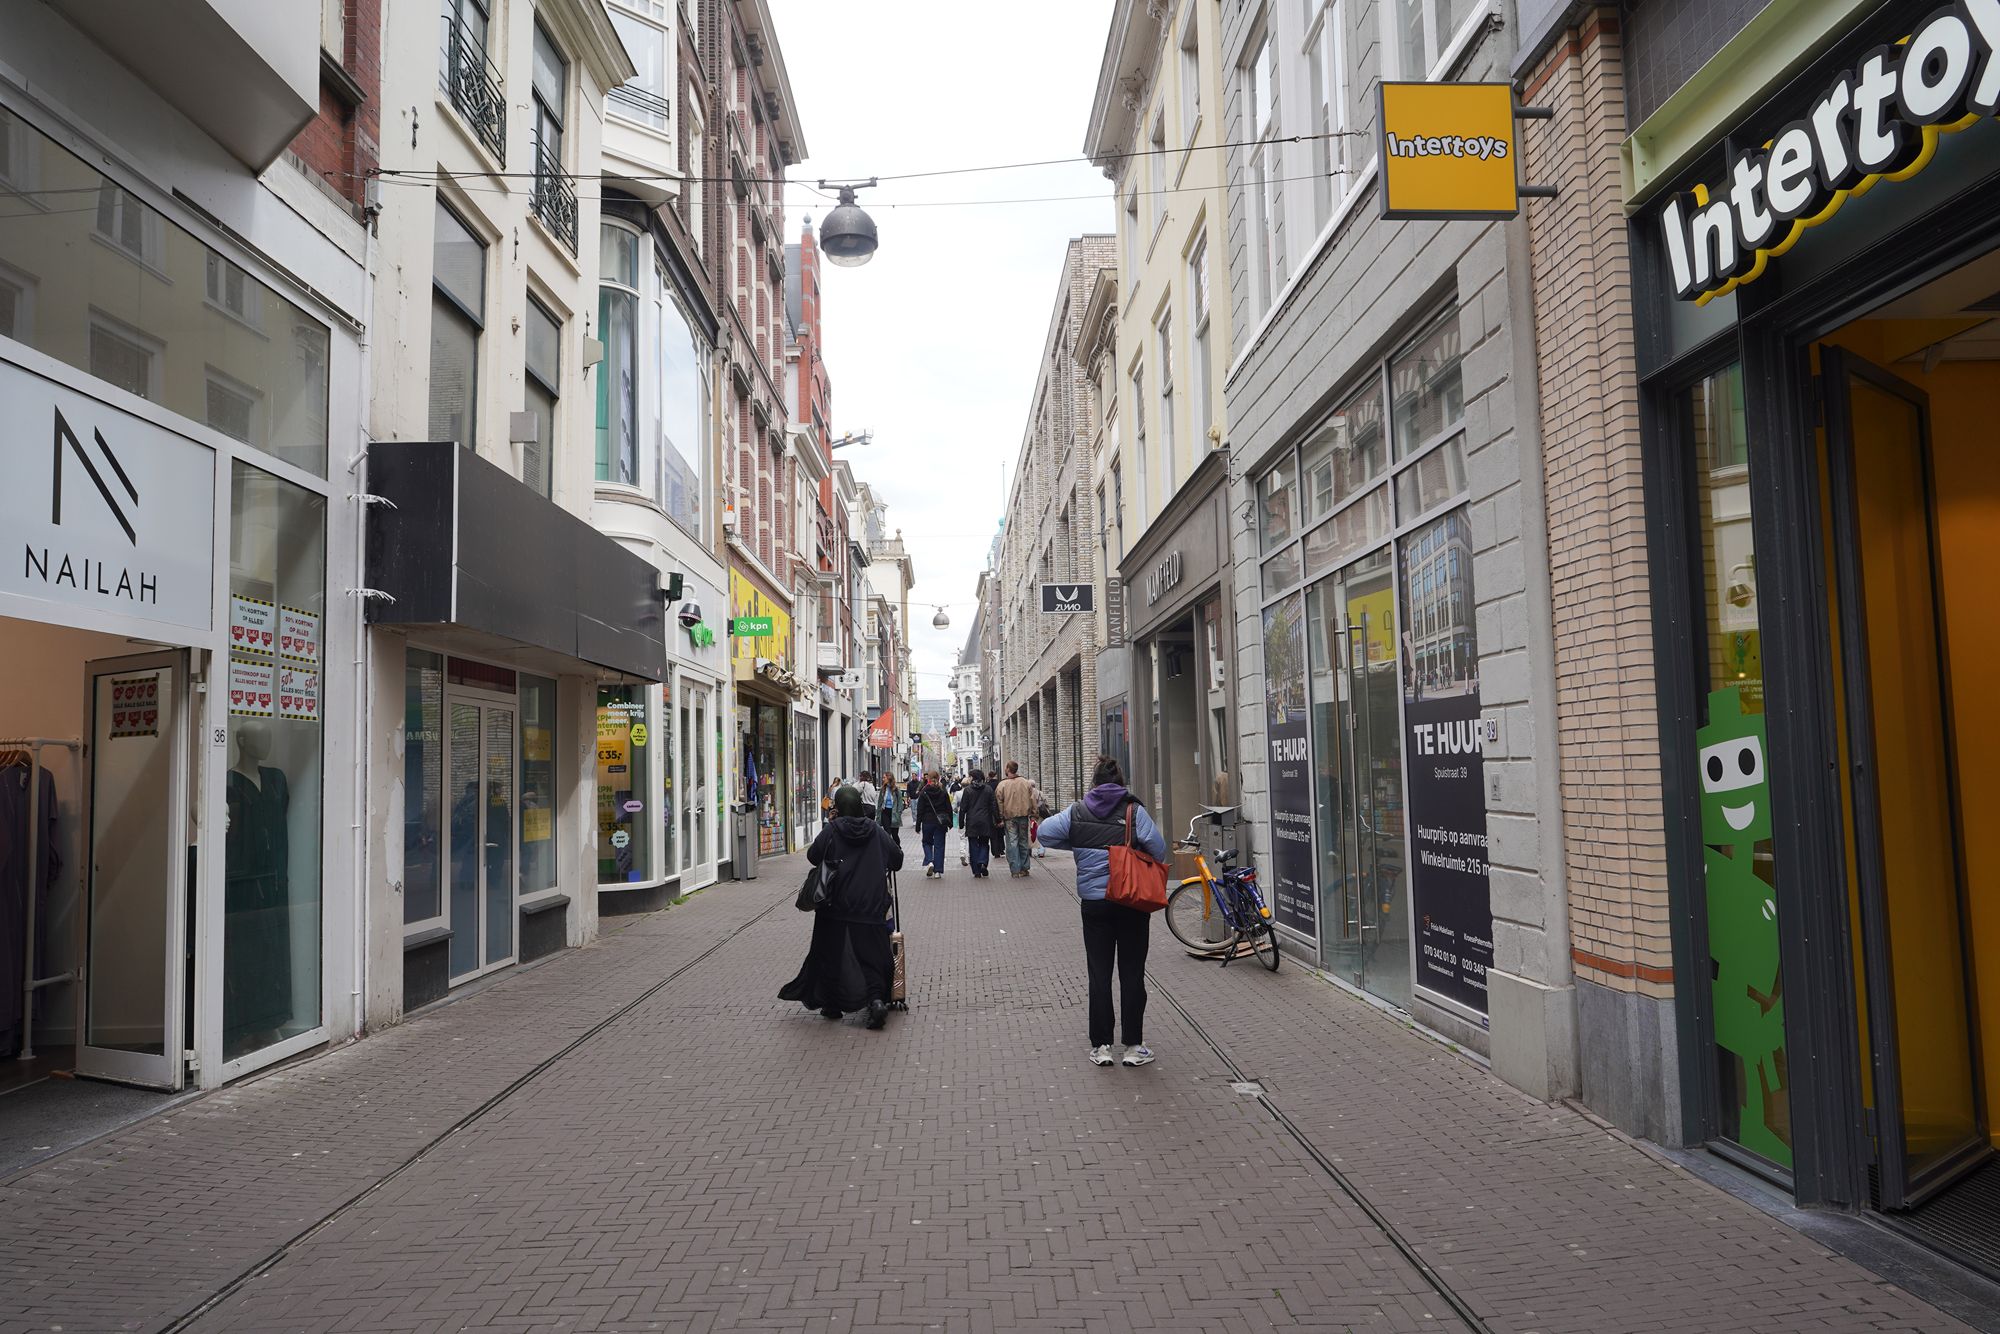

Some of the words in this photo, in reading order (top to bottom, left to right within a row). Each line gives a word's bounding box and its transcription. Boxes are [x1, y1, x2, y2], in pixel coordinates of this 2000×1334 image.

[1387, 132, 1508, 160] Intertoys
[25, 543, 156, 604] NAILAH
[247, 608, 268, 617] KORTING
[1054, 603, 1081, 611] ZUMO
[1110, 578, 1121, 646] MANFIELD
[295, 618, 313, 628] KORTING
[750, 622, 768, 631] kpn
[630, 709, 644, 718] krijg
[214, 729, 226, 743] 36
[1414, 724, 1434, 755] TE
[1436, 719, 1482, 755] HUUR
[1486, 720, 1496, 738] 39
[1272, 740, 1282, 761] TE
[1283, 738, 1307, 761] HUUR
[1434, 767, 1459, 780] Spuistraat
[1460, 766, 1468, 778] 39
[1417, 824, 1448, 845] Huurprijs
[1449, 833, 1458, 847] op
[1421, 850, 1466, 873] Winkelruimte
[1467, 857, 1481, 874] 215
[1424, 944, 1433, 957] 070
[1433, 948, 1443, 960] 342
[1443, 951, 1449, 963] 01
[1449, 954, 1457, 965] 30
[1462, 958, 1473, 972] 020
[1473, 961, 1485, 976] 346
